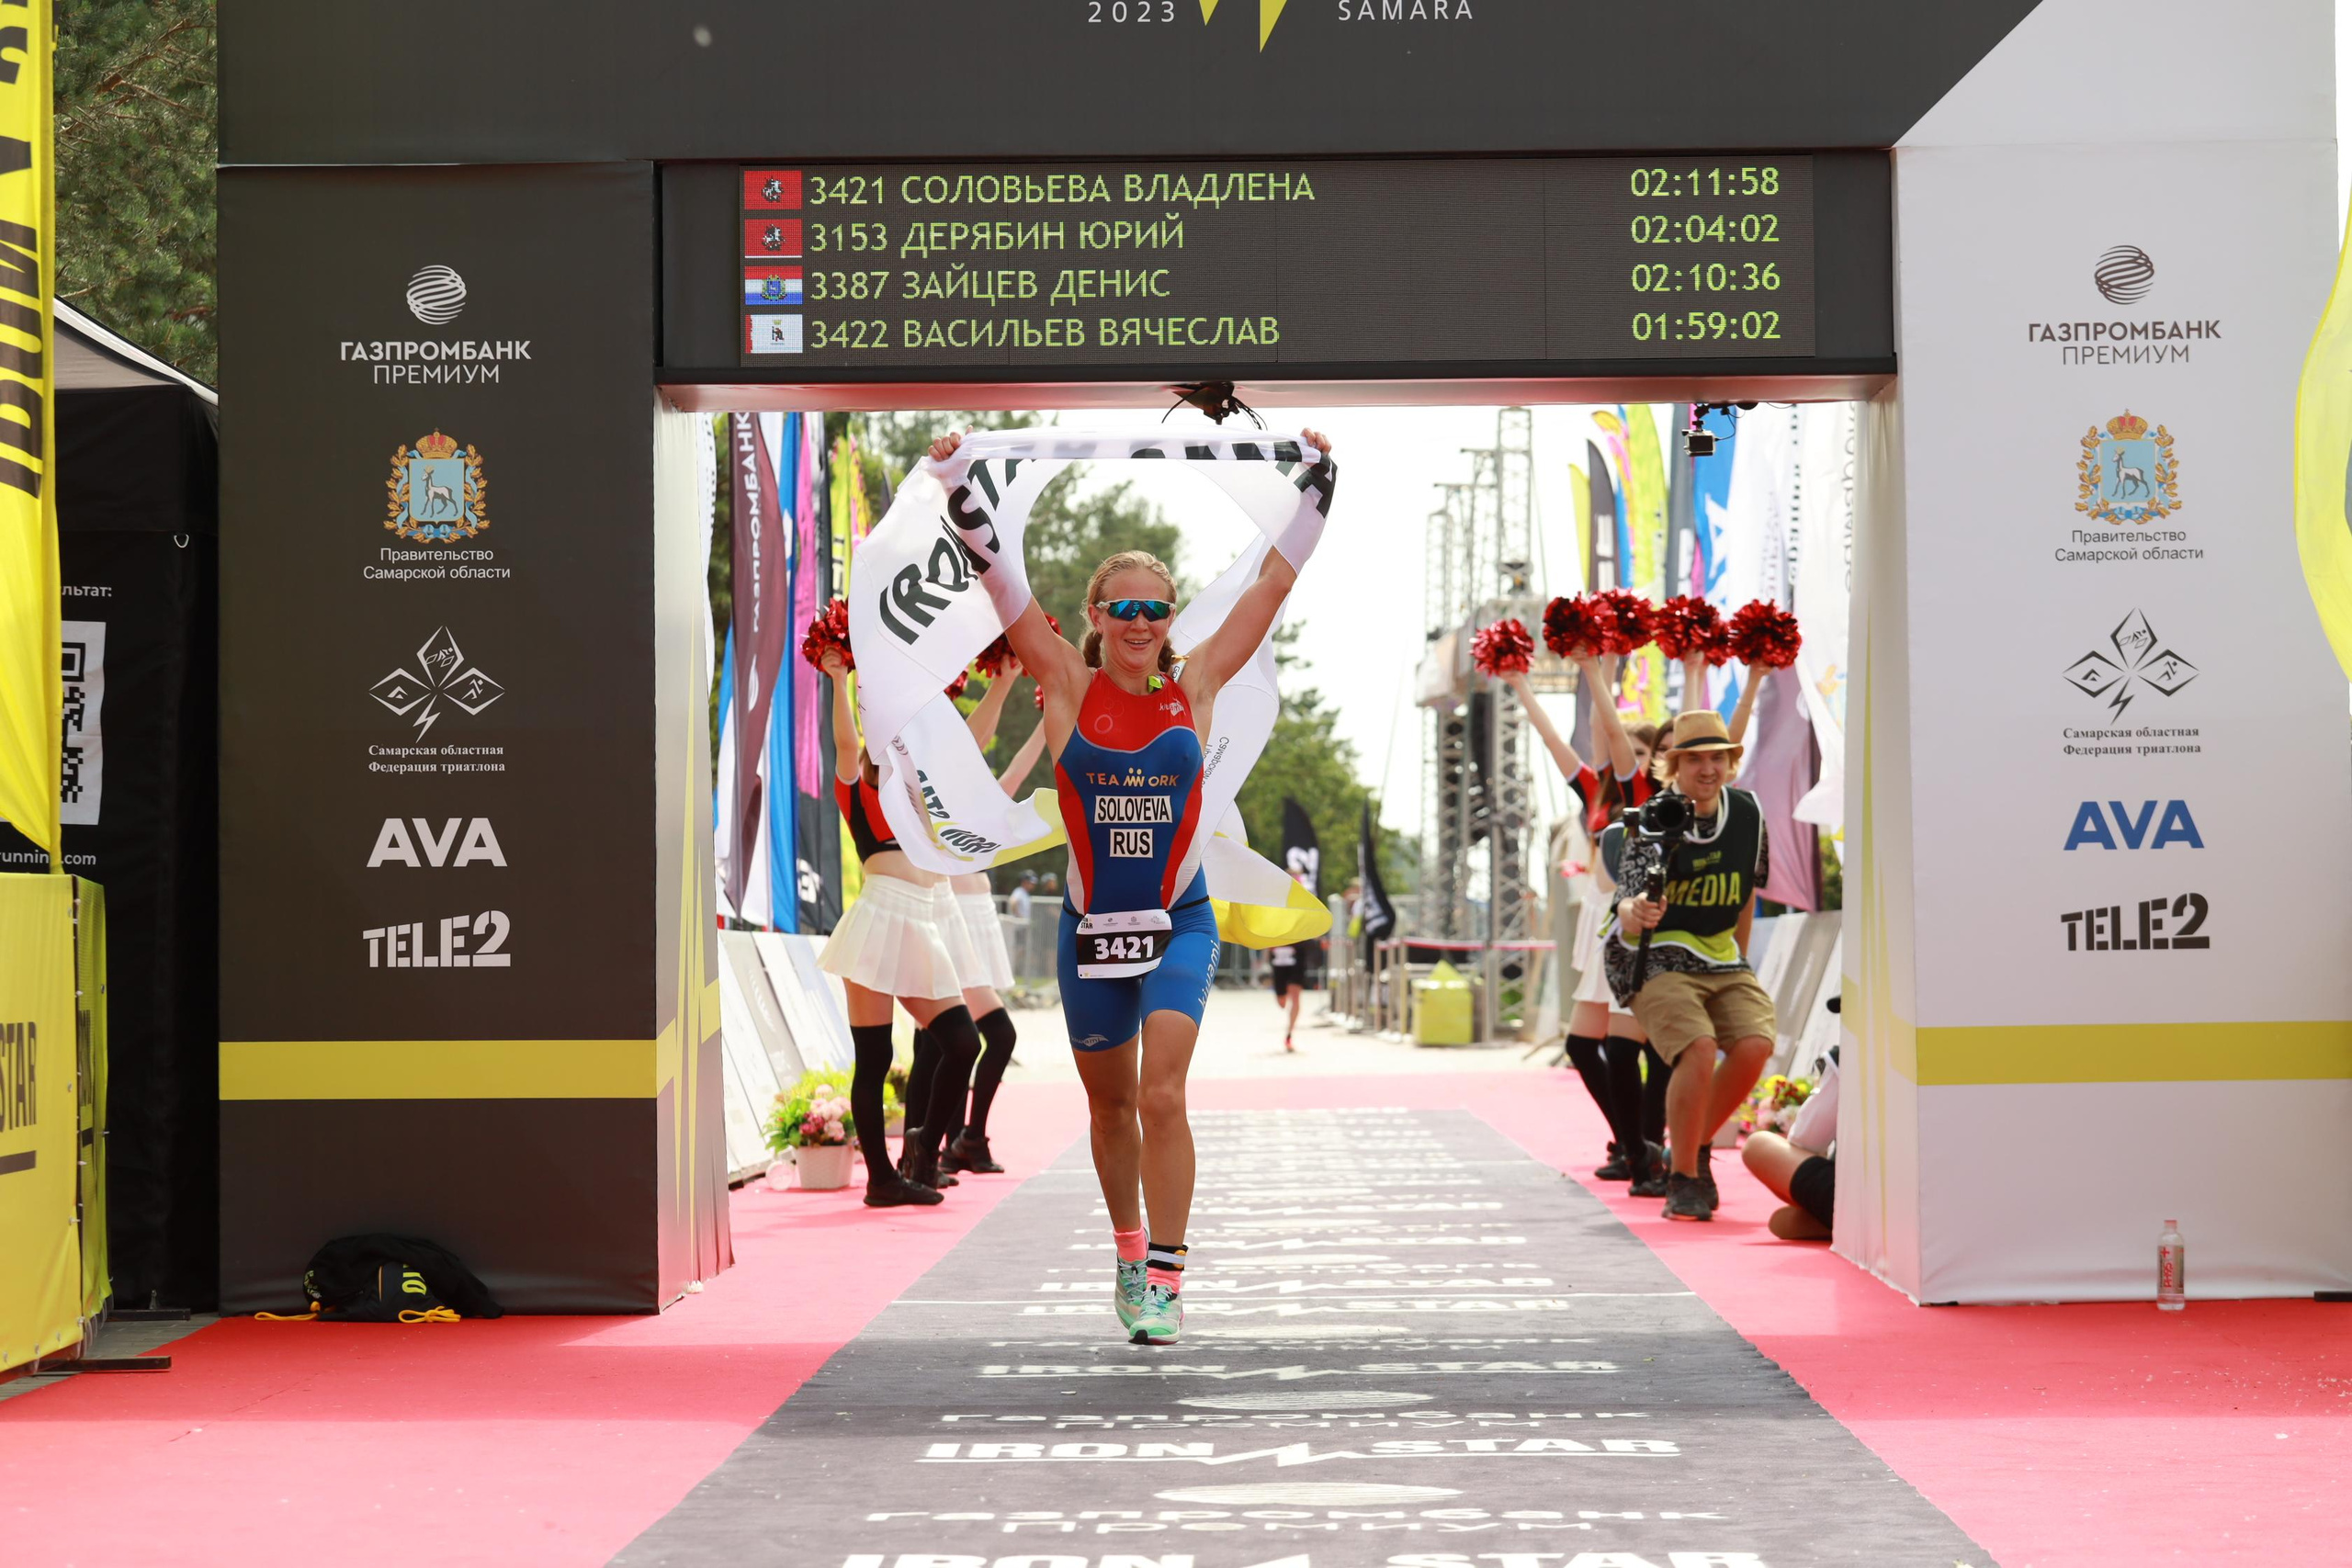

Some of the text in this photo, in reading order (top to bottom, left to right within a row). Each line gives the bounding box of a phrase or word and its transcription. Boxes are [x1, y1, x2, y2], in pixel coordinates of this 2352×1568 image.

[1088, 1, 1175, 23] 2023
[1338, 0, 1473, 20] SAMARA
[812, 173, 1316, 209] 3421 СОЛОВЬЕВА ВЛАДЛЕНА
[1631, 167, 1780, 197] 02:11:58
[810, 213, 1184, 258] 3153 ДЕРЯБИН ЮРИЙ
[1631, 213, 1781, 243] 02:04:02
[811, 264, 1171, 307] 3387 ЗАЙЦЕВ ДЕНИС
[1631, 262, 1781, 292] 02:10:36
[811, 316, 1282, 349] 3422 ВАСИЛЬЕВ ВЯЧЕСЛАВ
[1632, 310, 1781, 341] 01:59:02
[2028, 320, 2222, 343] ГАЗПРОМБАНК
[340, 340, 532, 361] ГАЗПРОМБАНК
[2062, 343, 2190, 366] ПРЕМИУМ
[373, 364, 500, 384] ПРЕМИУМ
[2071, 529, 2187, 546] Правительство
[379, 547, 494, 564] Правительство
[2054, 544, 2204, 564] Самарской области
[363, 563, 511, 582] Самарской области
[2063, 726, 2199, 741] Самарская областная
[368, 744, 503, 759] Самарская областная
[2063, 744, 2201, 759] Федерация триатлона
[368, 761, 505, 775] Федерация триатлона
[1097, 797, 1170, 821] SOLOVEVA
[2064, 800, 2205, 851] AVA
[367, 818, 508, 867] AVA
[1113, 830, 1151, 856] RUS
[1666, 872, 1741, 907] MEDIA
[2061, 893, 2211, 951] TELE2
[362, 910, 512, 967] TELE2
[1093, 935, 1154, 961] 3421
[924, 1438, 1682, 1458] IRON STAR
